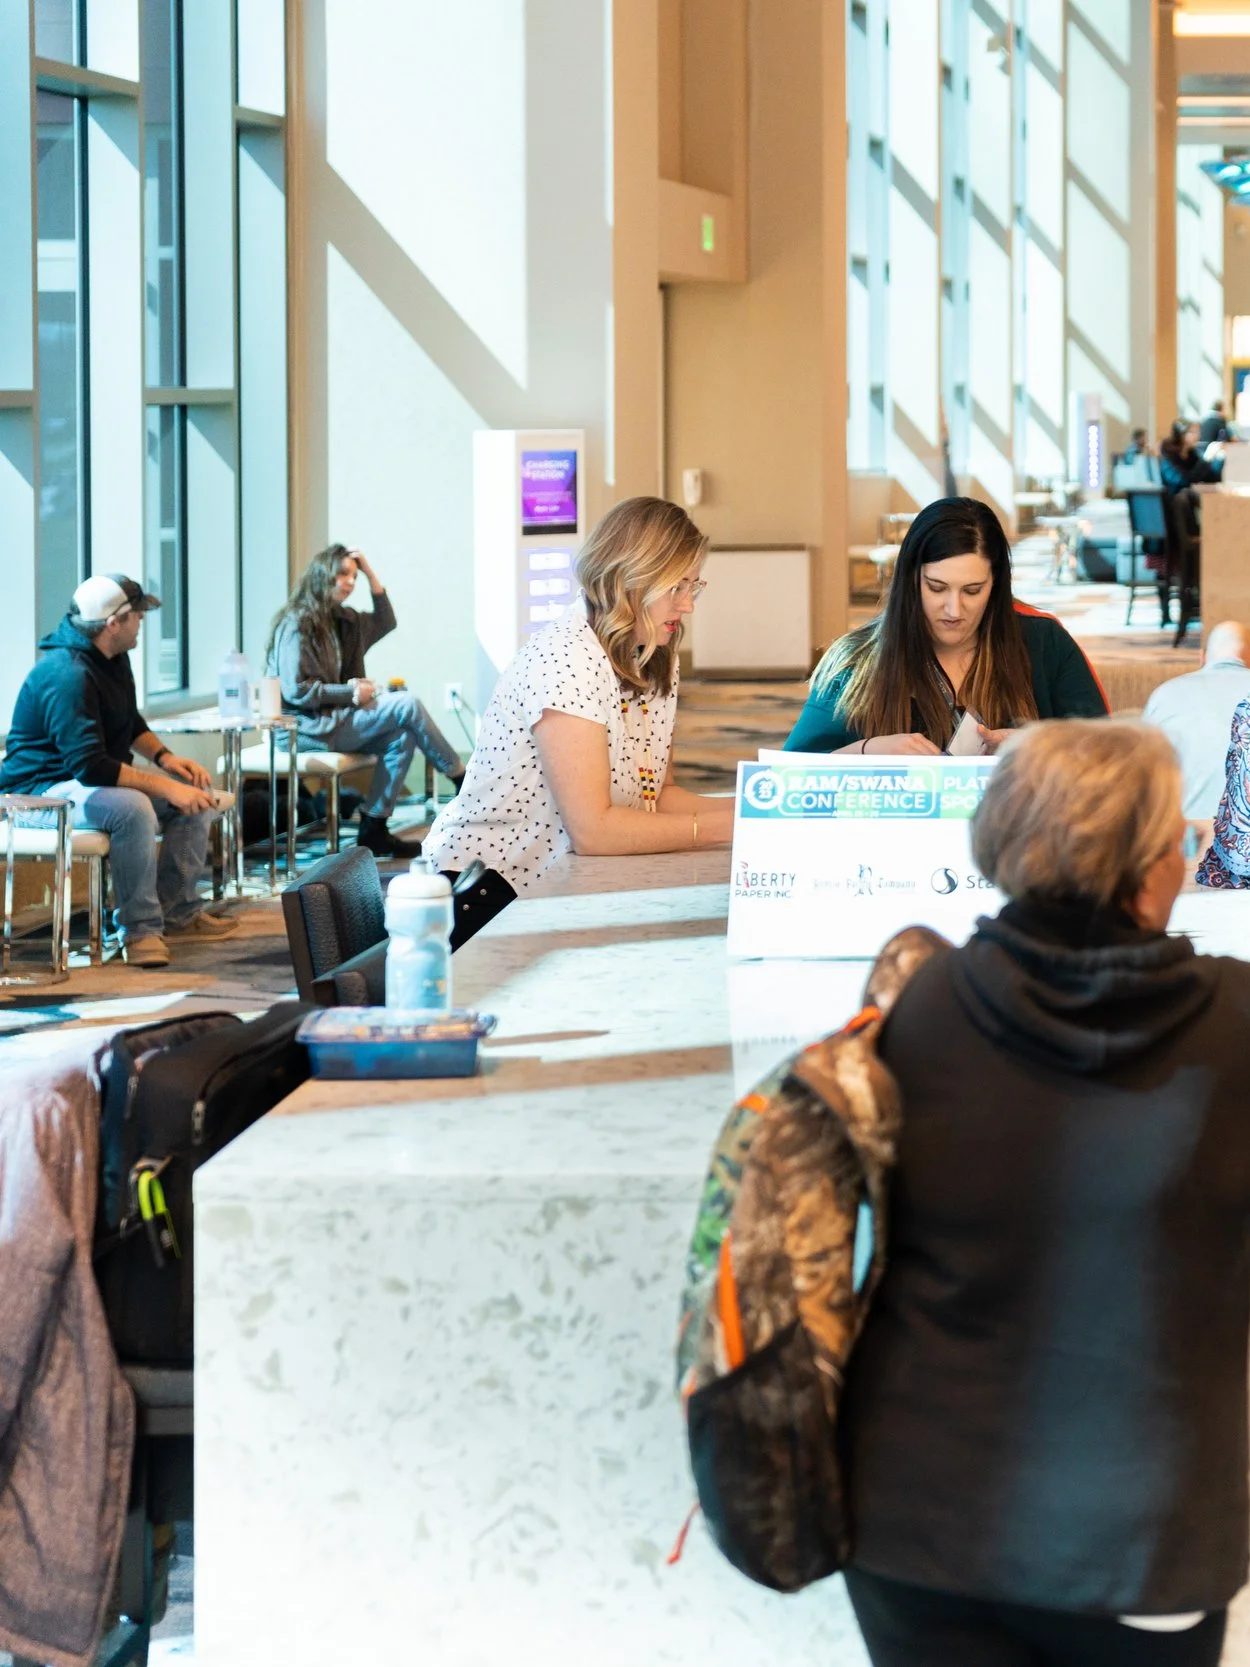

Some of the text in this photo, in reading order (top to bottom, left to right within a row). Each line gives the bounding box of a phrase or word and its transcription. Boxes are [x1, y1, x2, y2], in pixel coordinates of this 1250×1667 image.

[786, 792, 925, 809] CONFERENCE
[940, 795, 983, 810] SPO
[734, 889, 771, 899] PAPER
